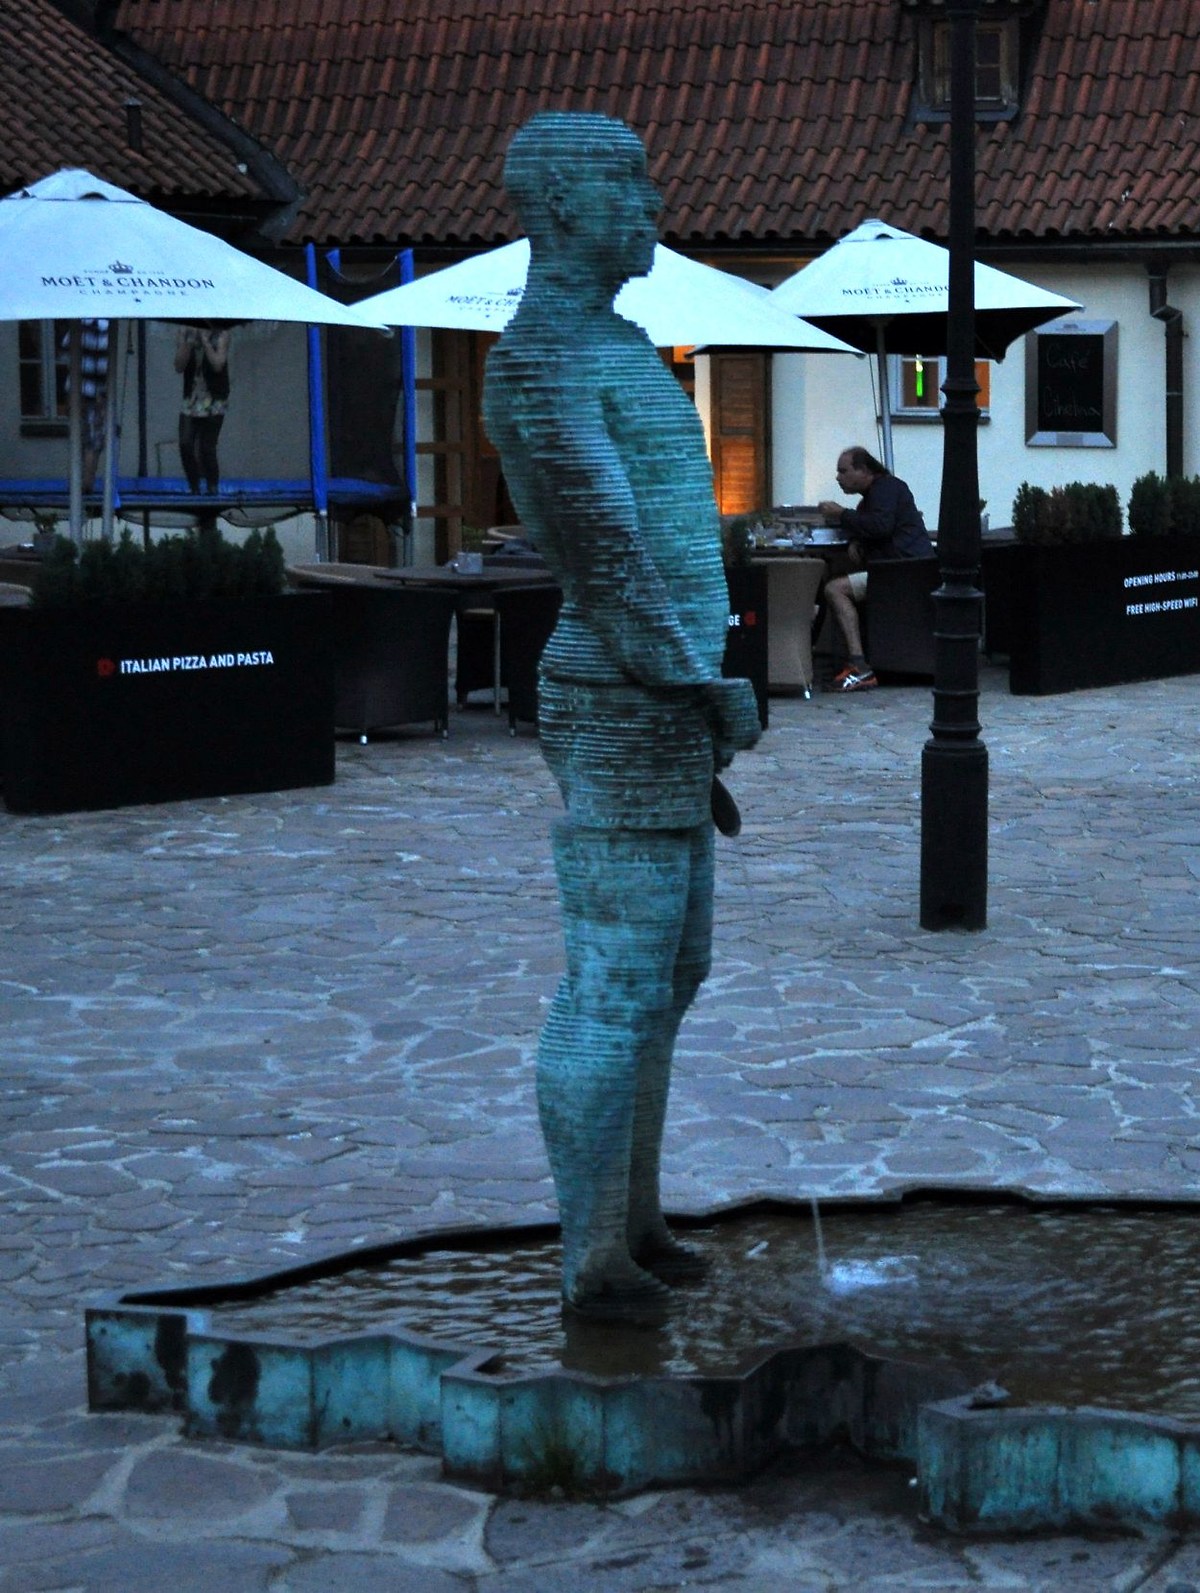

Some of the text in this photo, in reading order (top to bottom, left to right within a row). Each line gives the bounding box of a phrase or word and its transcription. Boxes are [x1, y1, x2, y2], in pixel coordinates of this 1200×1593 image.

[102, 278, 113, 287] &
[117, 277, 215, 289] CHANDON
[895, 284, 949, 294] CHAND
[1124, 574, 1153, 588] OPENING
[1154, 571, 1175, 583] HOURS
[1126, 597, 1198, 615] FREE HIGH-SPEED WIFI
[121, 651, 274, 674] ITALIAN PIZZA AND PASTA
